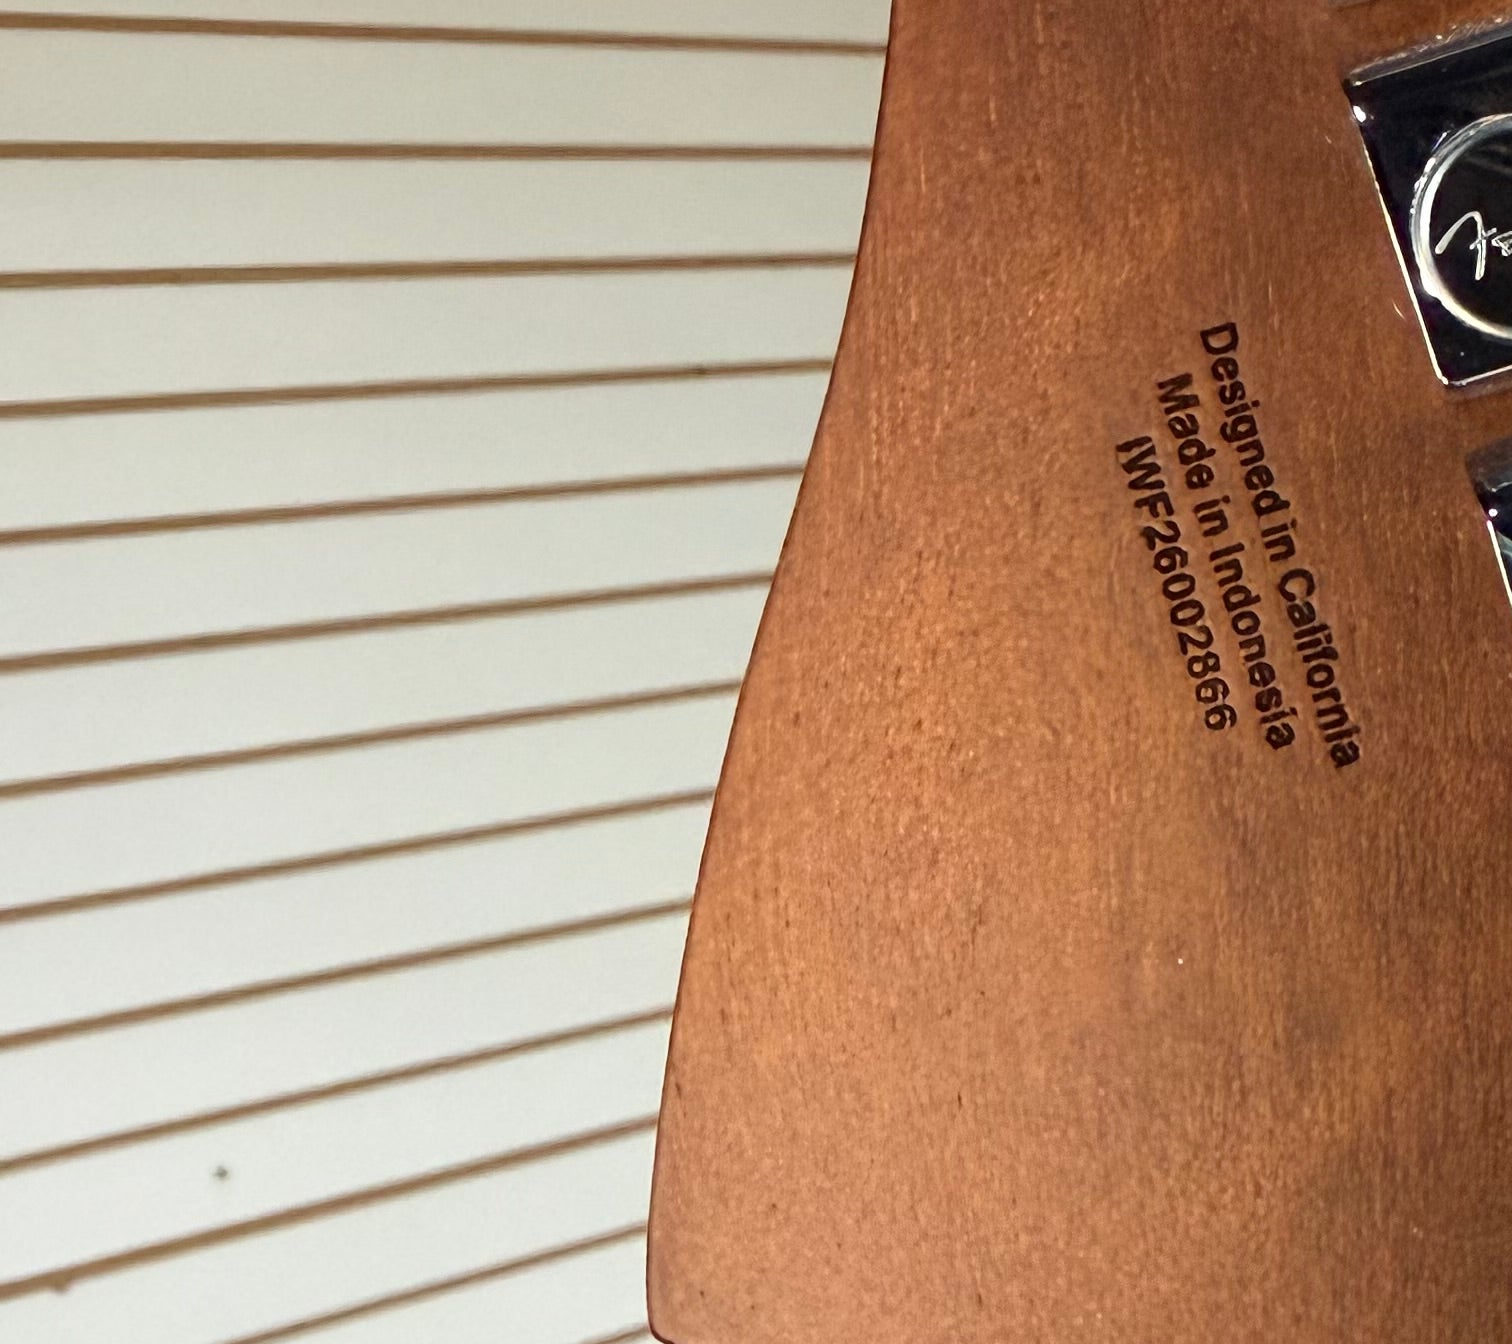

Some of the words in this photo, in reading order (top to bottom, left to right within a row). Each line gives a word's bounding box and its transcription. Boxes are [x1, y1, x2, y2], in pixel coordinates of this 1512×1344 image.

[1157, 372, 1218, 492] Made
[1193, 494, 1231, 538] in
[1200, 321, 1291, 520] Designed
[1115, 434, 1239, 732] IWF26002866
[1261, 517, 1299, 564] in
[1208, 542, 1297, 752] Indonesia
[1277, 567, 1362, 770] California
